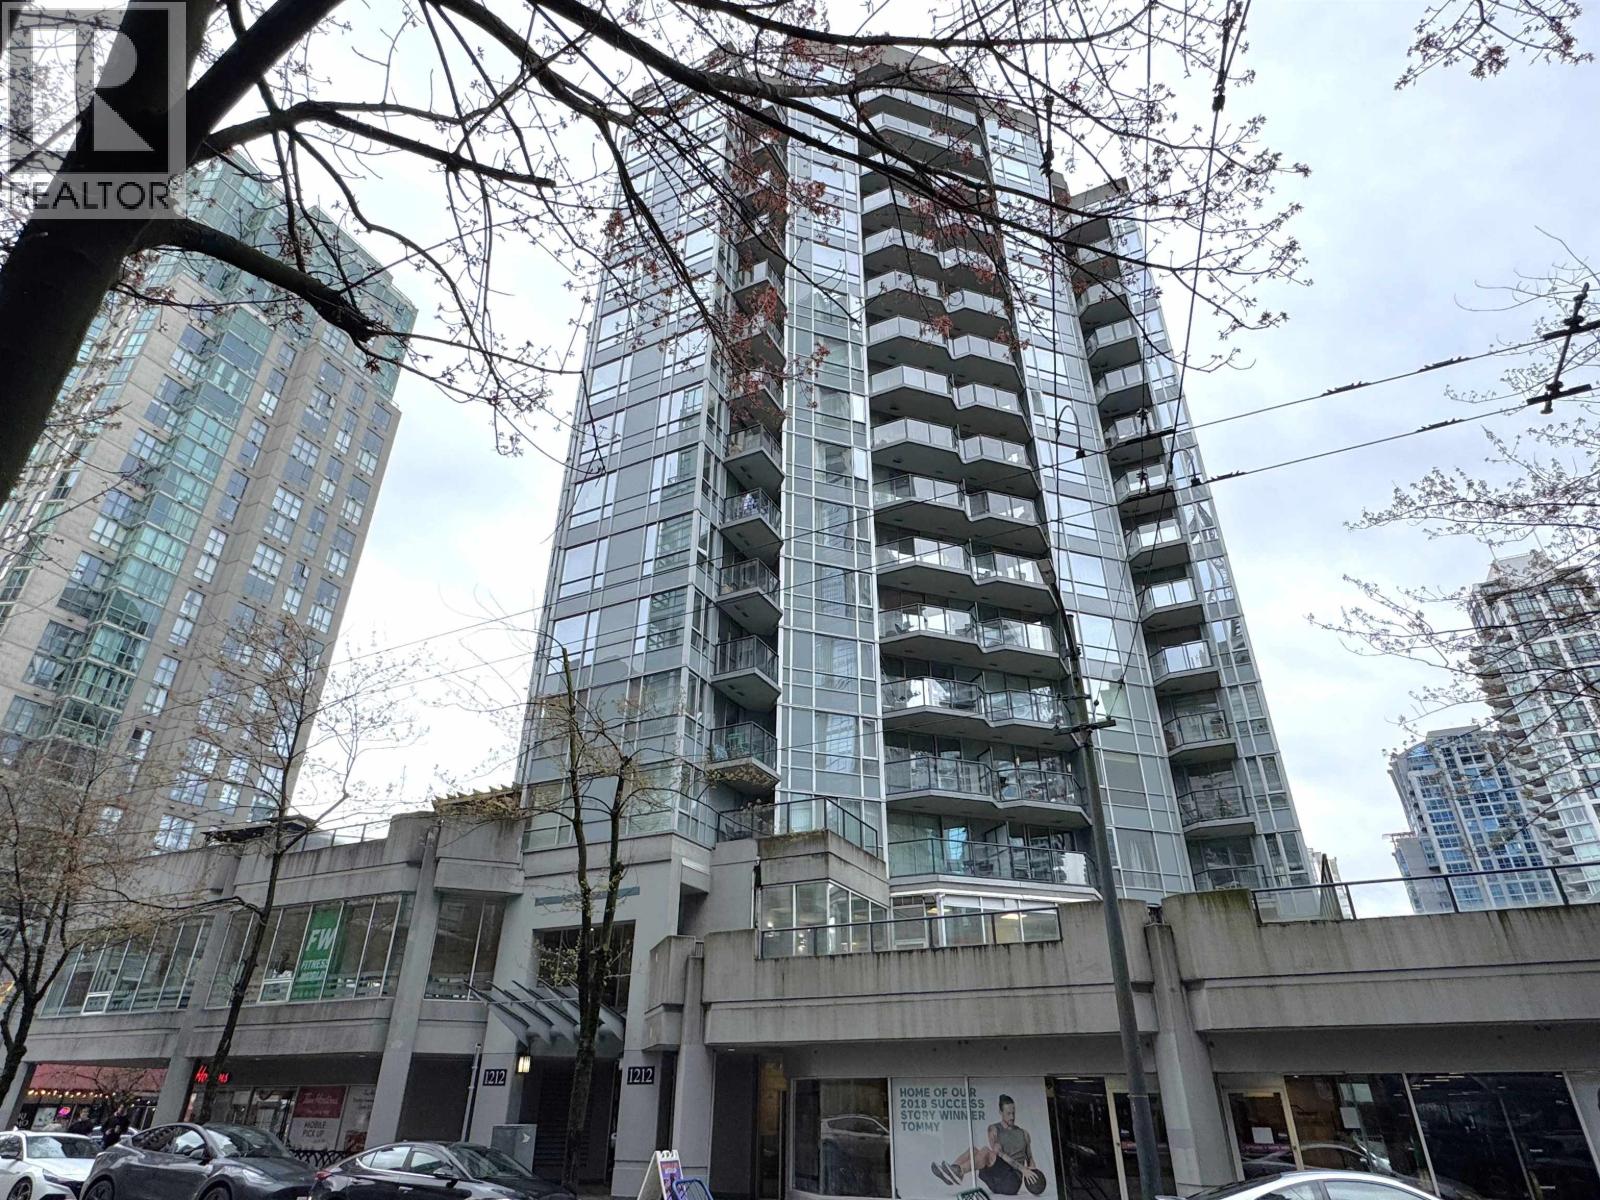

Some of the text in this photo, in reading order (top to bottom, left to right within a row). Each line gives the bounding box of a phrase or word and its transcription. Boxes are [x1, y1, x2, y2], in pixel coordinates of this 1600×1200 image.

[484, 1070, 505, 1085] 1212
[628, 1067, 653, 1084] 1212
[900, 1088, 977, 1097] HOME OF OUR
[900, 1099, 985, 1109] 2018 SUCCESS
[901, 1110, 985, 1120] STORY WINNER
[901, 1121, 940, 1131] TOMMY
